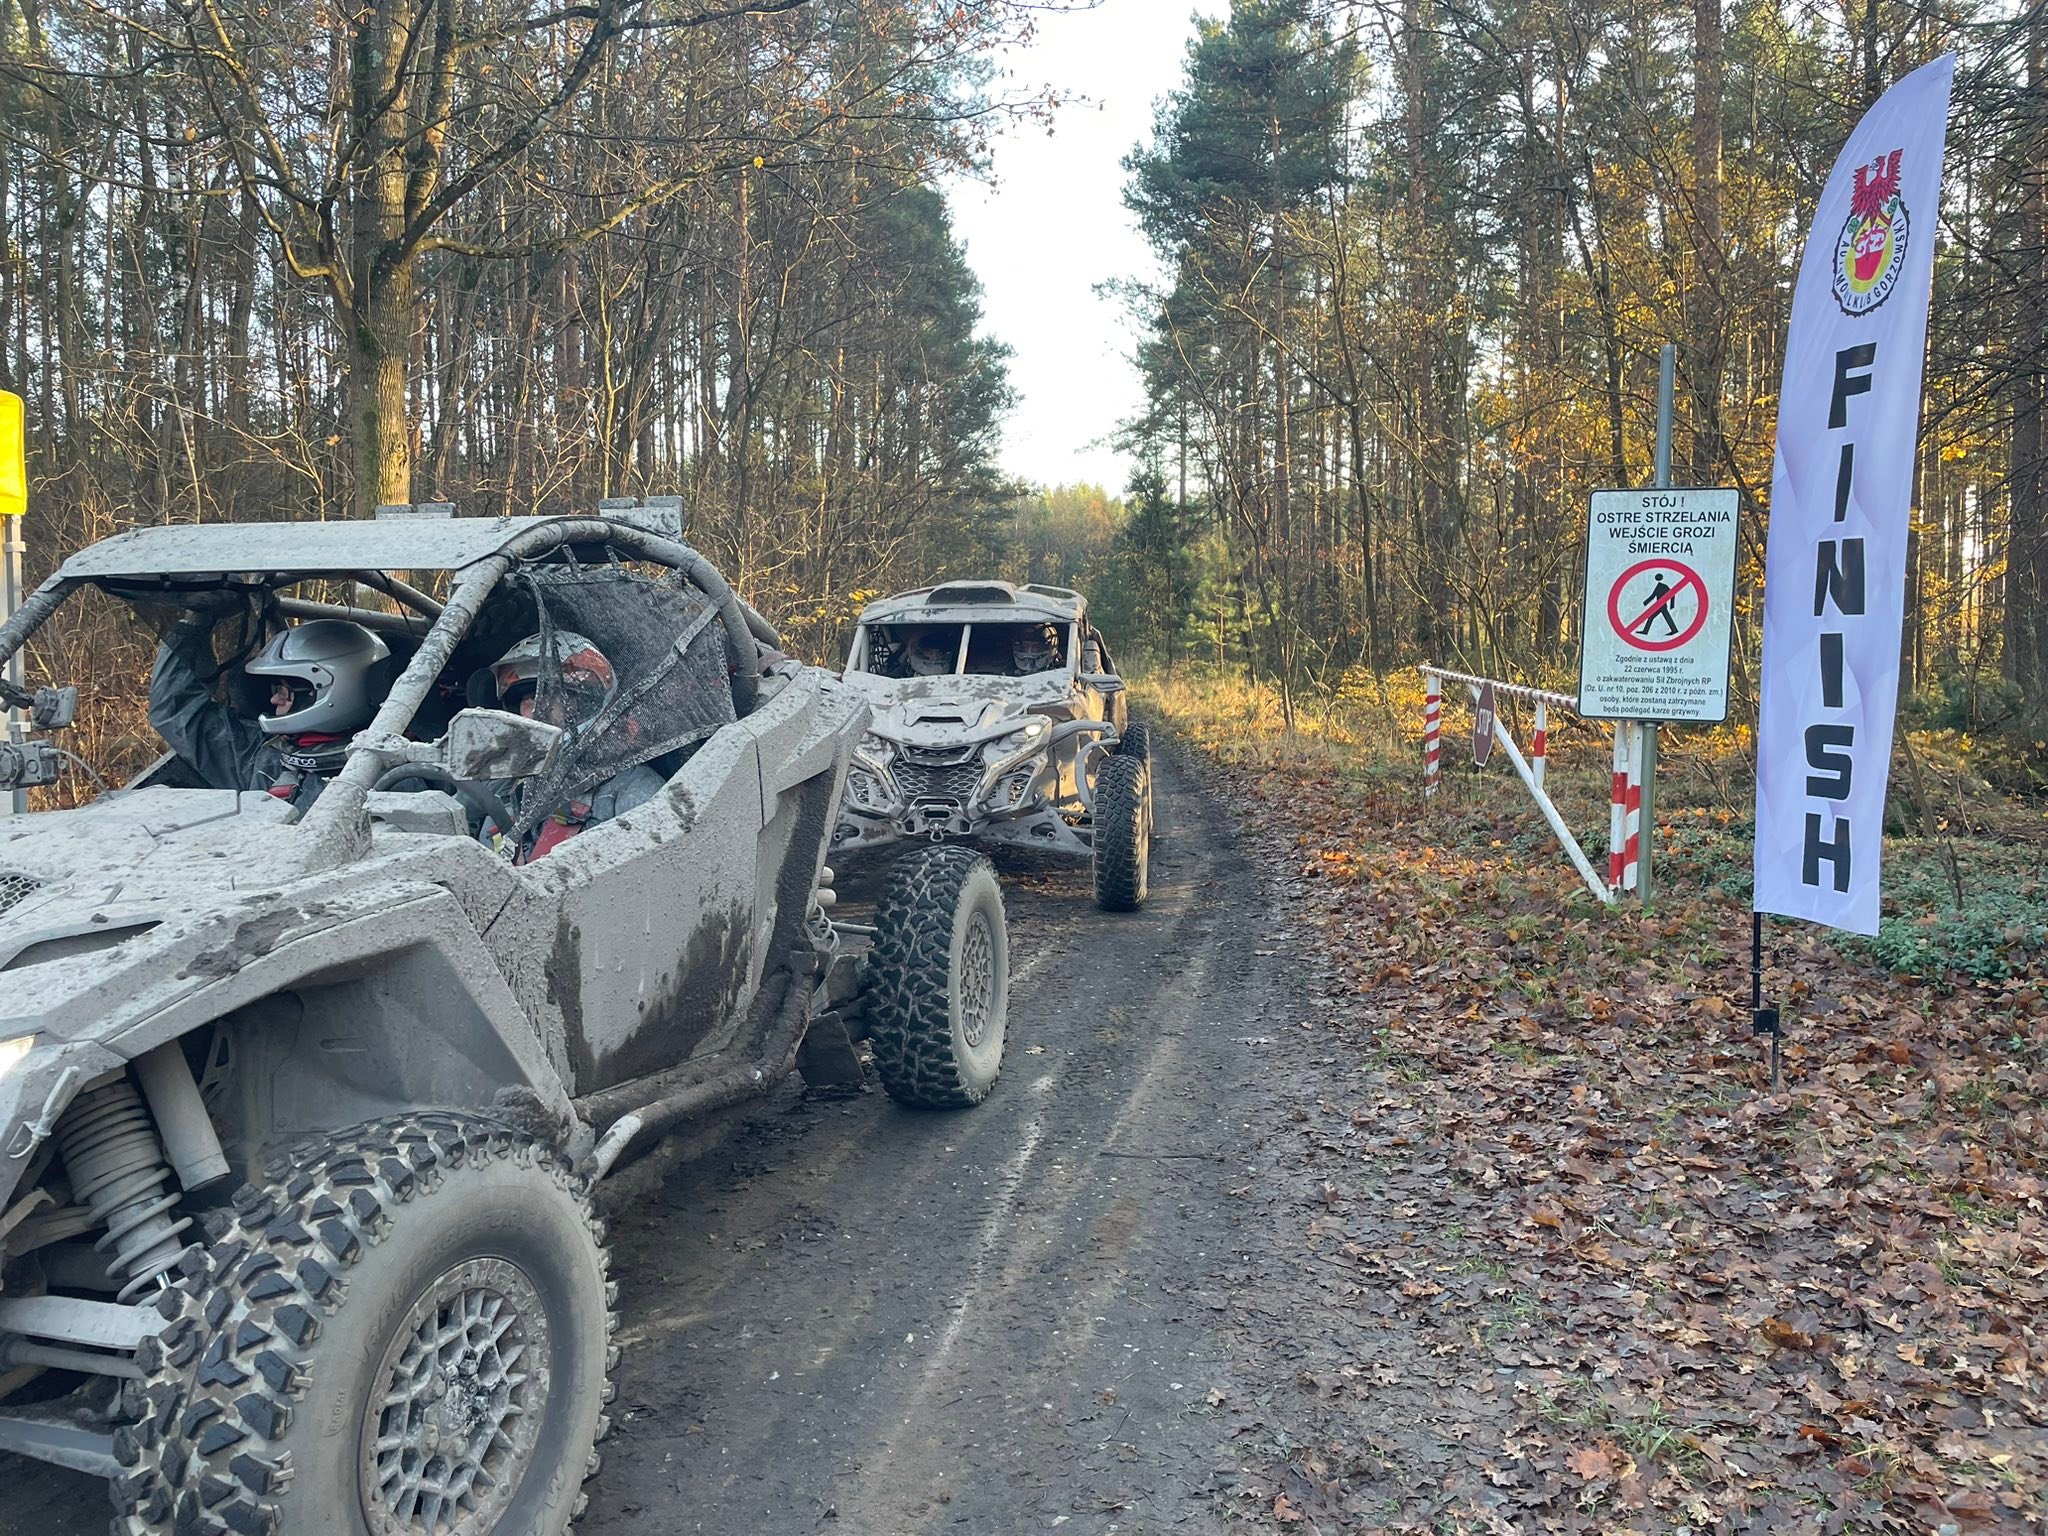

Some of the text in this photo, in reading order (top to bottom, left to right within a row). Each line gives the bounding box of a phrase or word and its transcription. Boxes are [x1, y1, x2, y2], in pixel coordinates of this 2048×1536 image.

[1874, 219, 1906, 297] GORZOWSKI
[1642, 494, 1676, 508] STÓJ
[1597, 512, 1730, 523] OSTRE STRZELANIA
[1610, 525, 1715, 538] WEJŚCIE GROZI
[1629, 540, 1694, 556] ŚMIERCIĄ
[1802, 342, 1877, 894] FINISH
[1616, 655, 1642, 664] Zgodnie
[1649, 656, 1672, 664] ustawą
[1680, 656, 1694, 664] dnia
[1666, 677, 1700, 686] Zbrojnych
[1627, 687, 1640, 695] poz.
[1642, 685, 1654, 693] 206
[1661, 686, 1675, 694] 2010
[1641, 697, 1666, 705] zostaną
[1668, 697, 1706, 706] zatrzymane
[1621, 706, 1650, 714] podlegać
